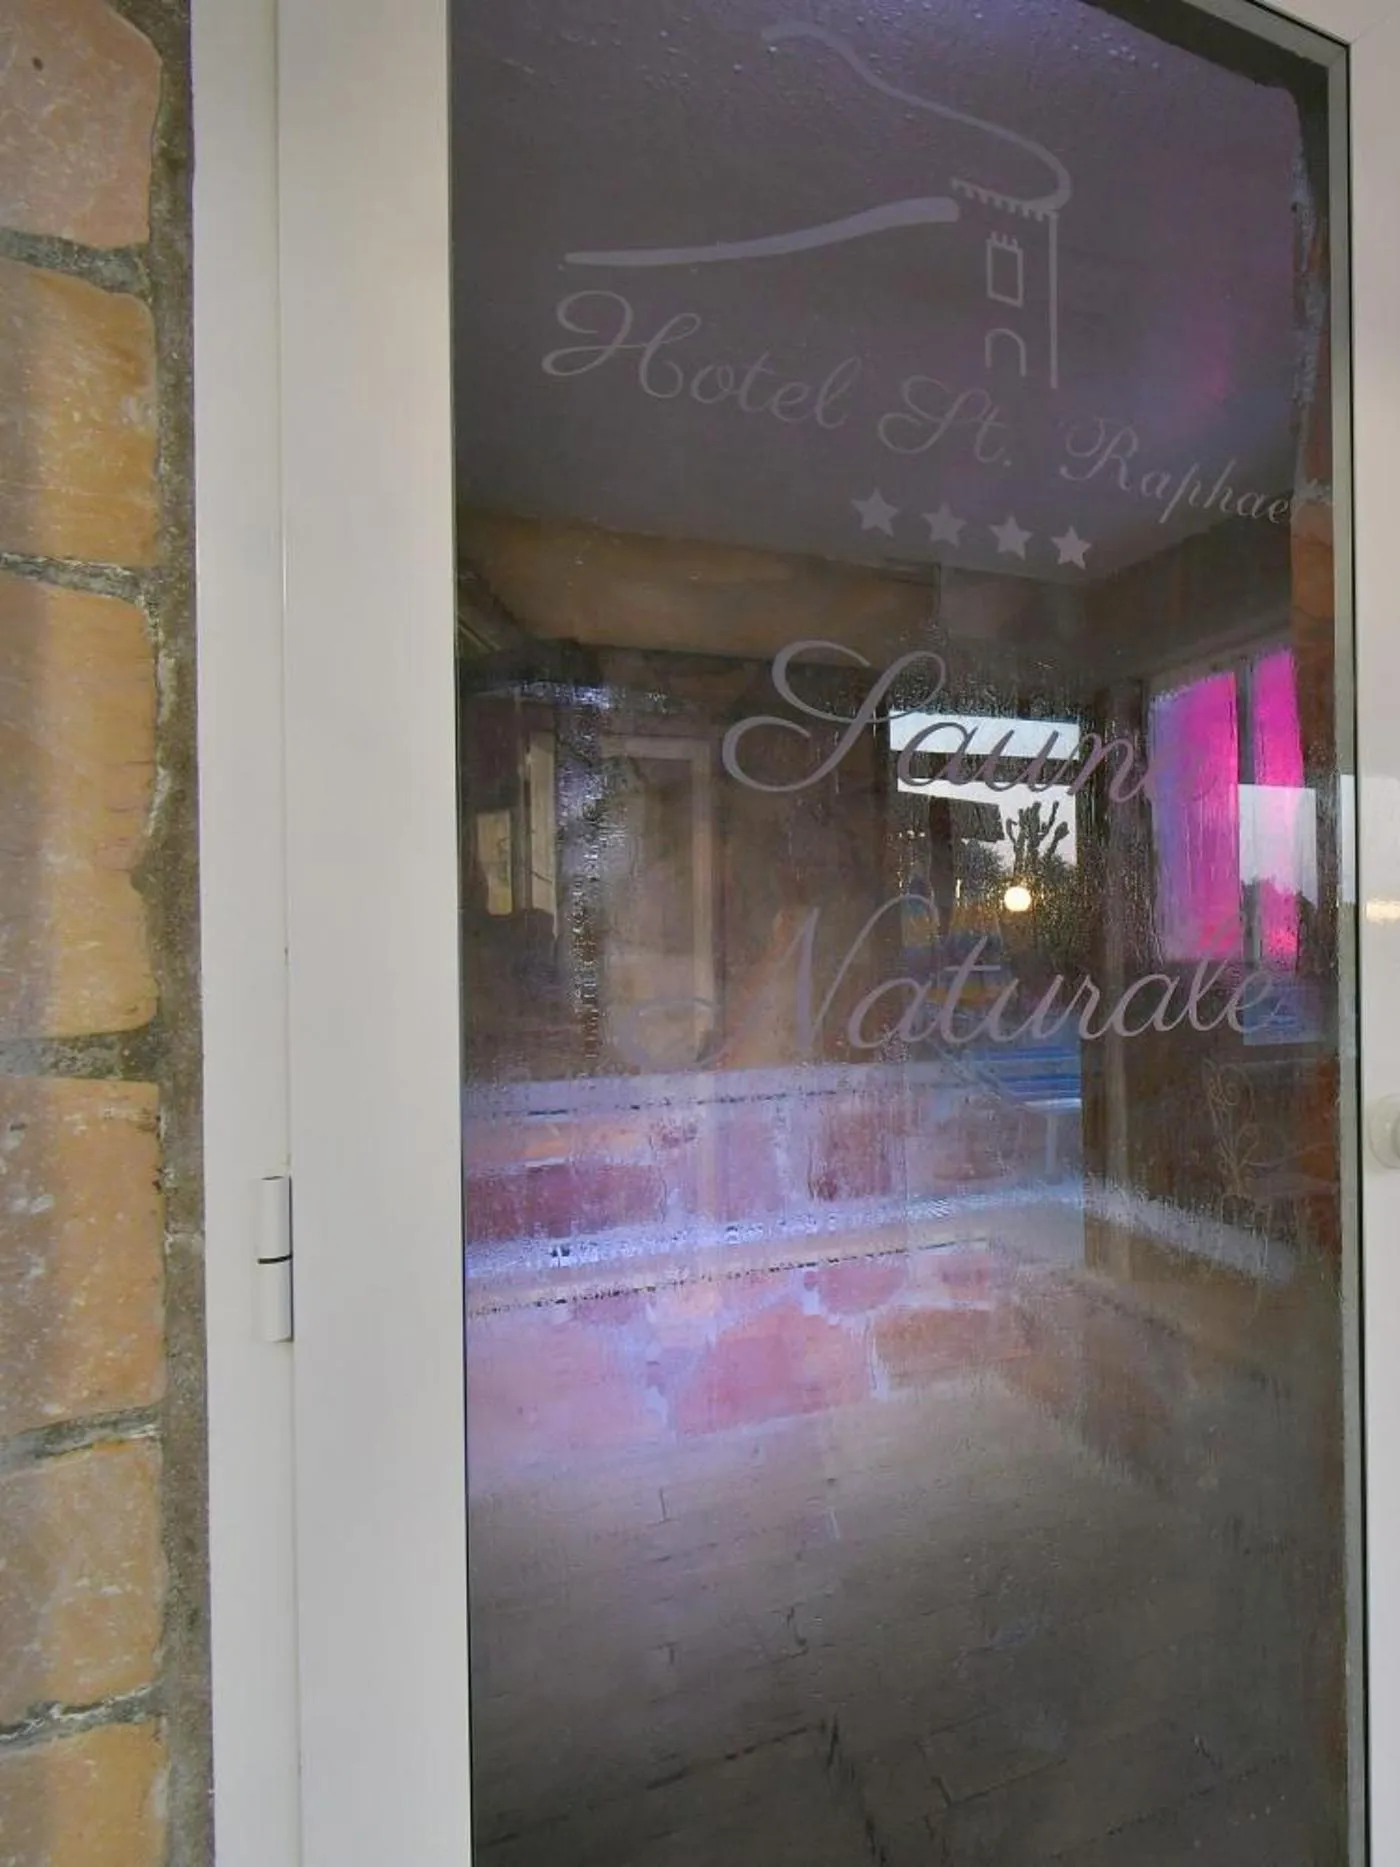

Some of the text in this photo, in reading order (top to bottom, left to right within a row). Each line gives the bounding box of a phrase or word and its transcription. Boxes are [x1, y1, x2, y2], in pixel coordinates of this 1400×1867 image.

[541, 289, 1298, 524] Hotel St. Raphae
[616, 893, 1287, 1068] Naturale
